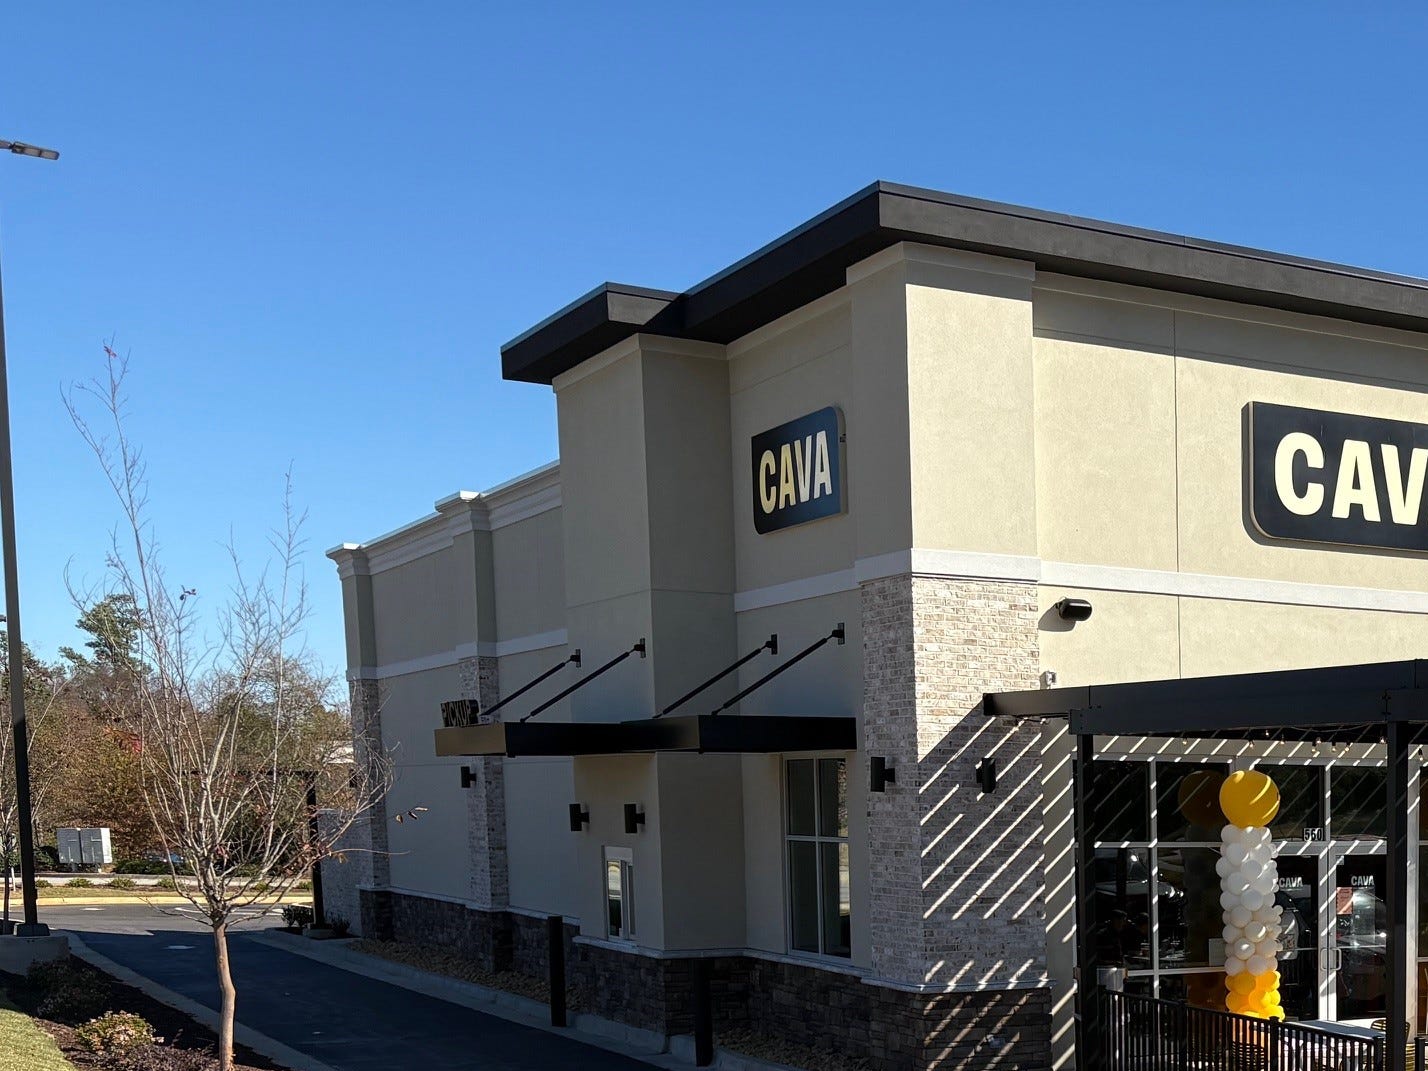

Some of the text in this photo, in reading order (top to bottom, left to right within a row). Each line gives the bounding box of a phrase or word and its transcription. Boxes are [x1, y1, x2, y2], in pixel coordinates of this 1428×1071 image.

[760, 431, 832, 514] CAVA
[441, 700, 471, 727] PICKUP
[1304, 828, 1323, 840] 560
[1280, 877, 1303, 888] CAVA
[1351, 875, 1375, 886] CAVA
